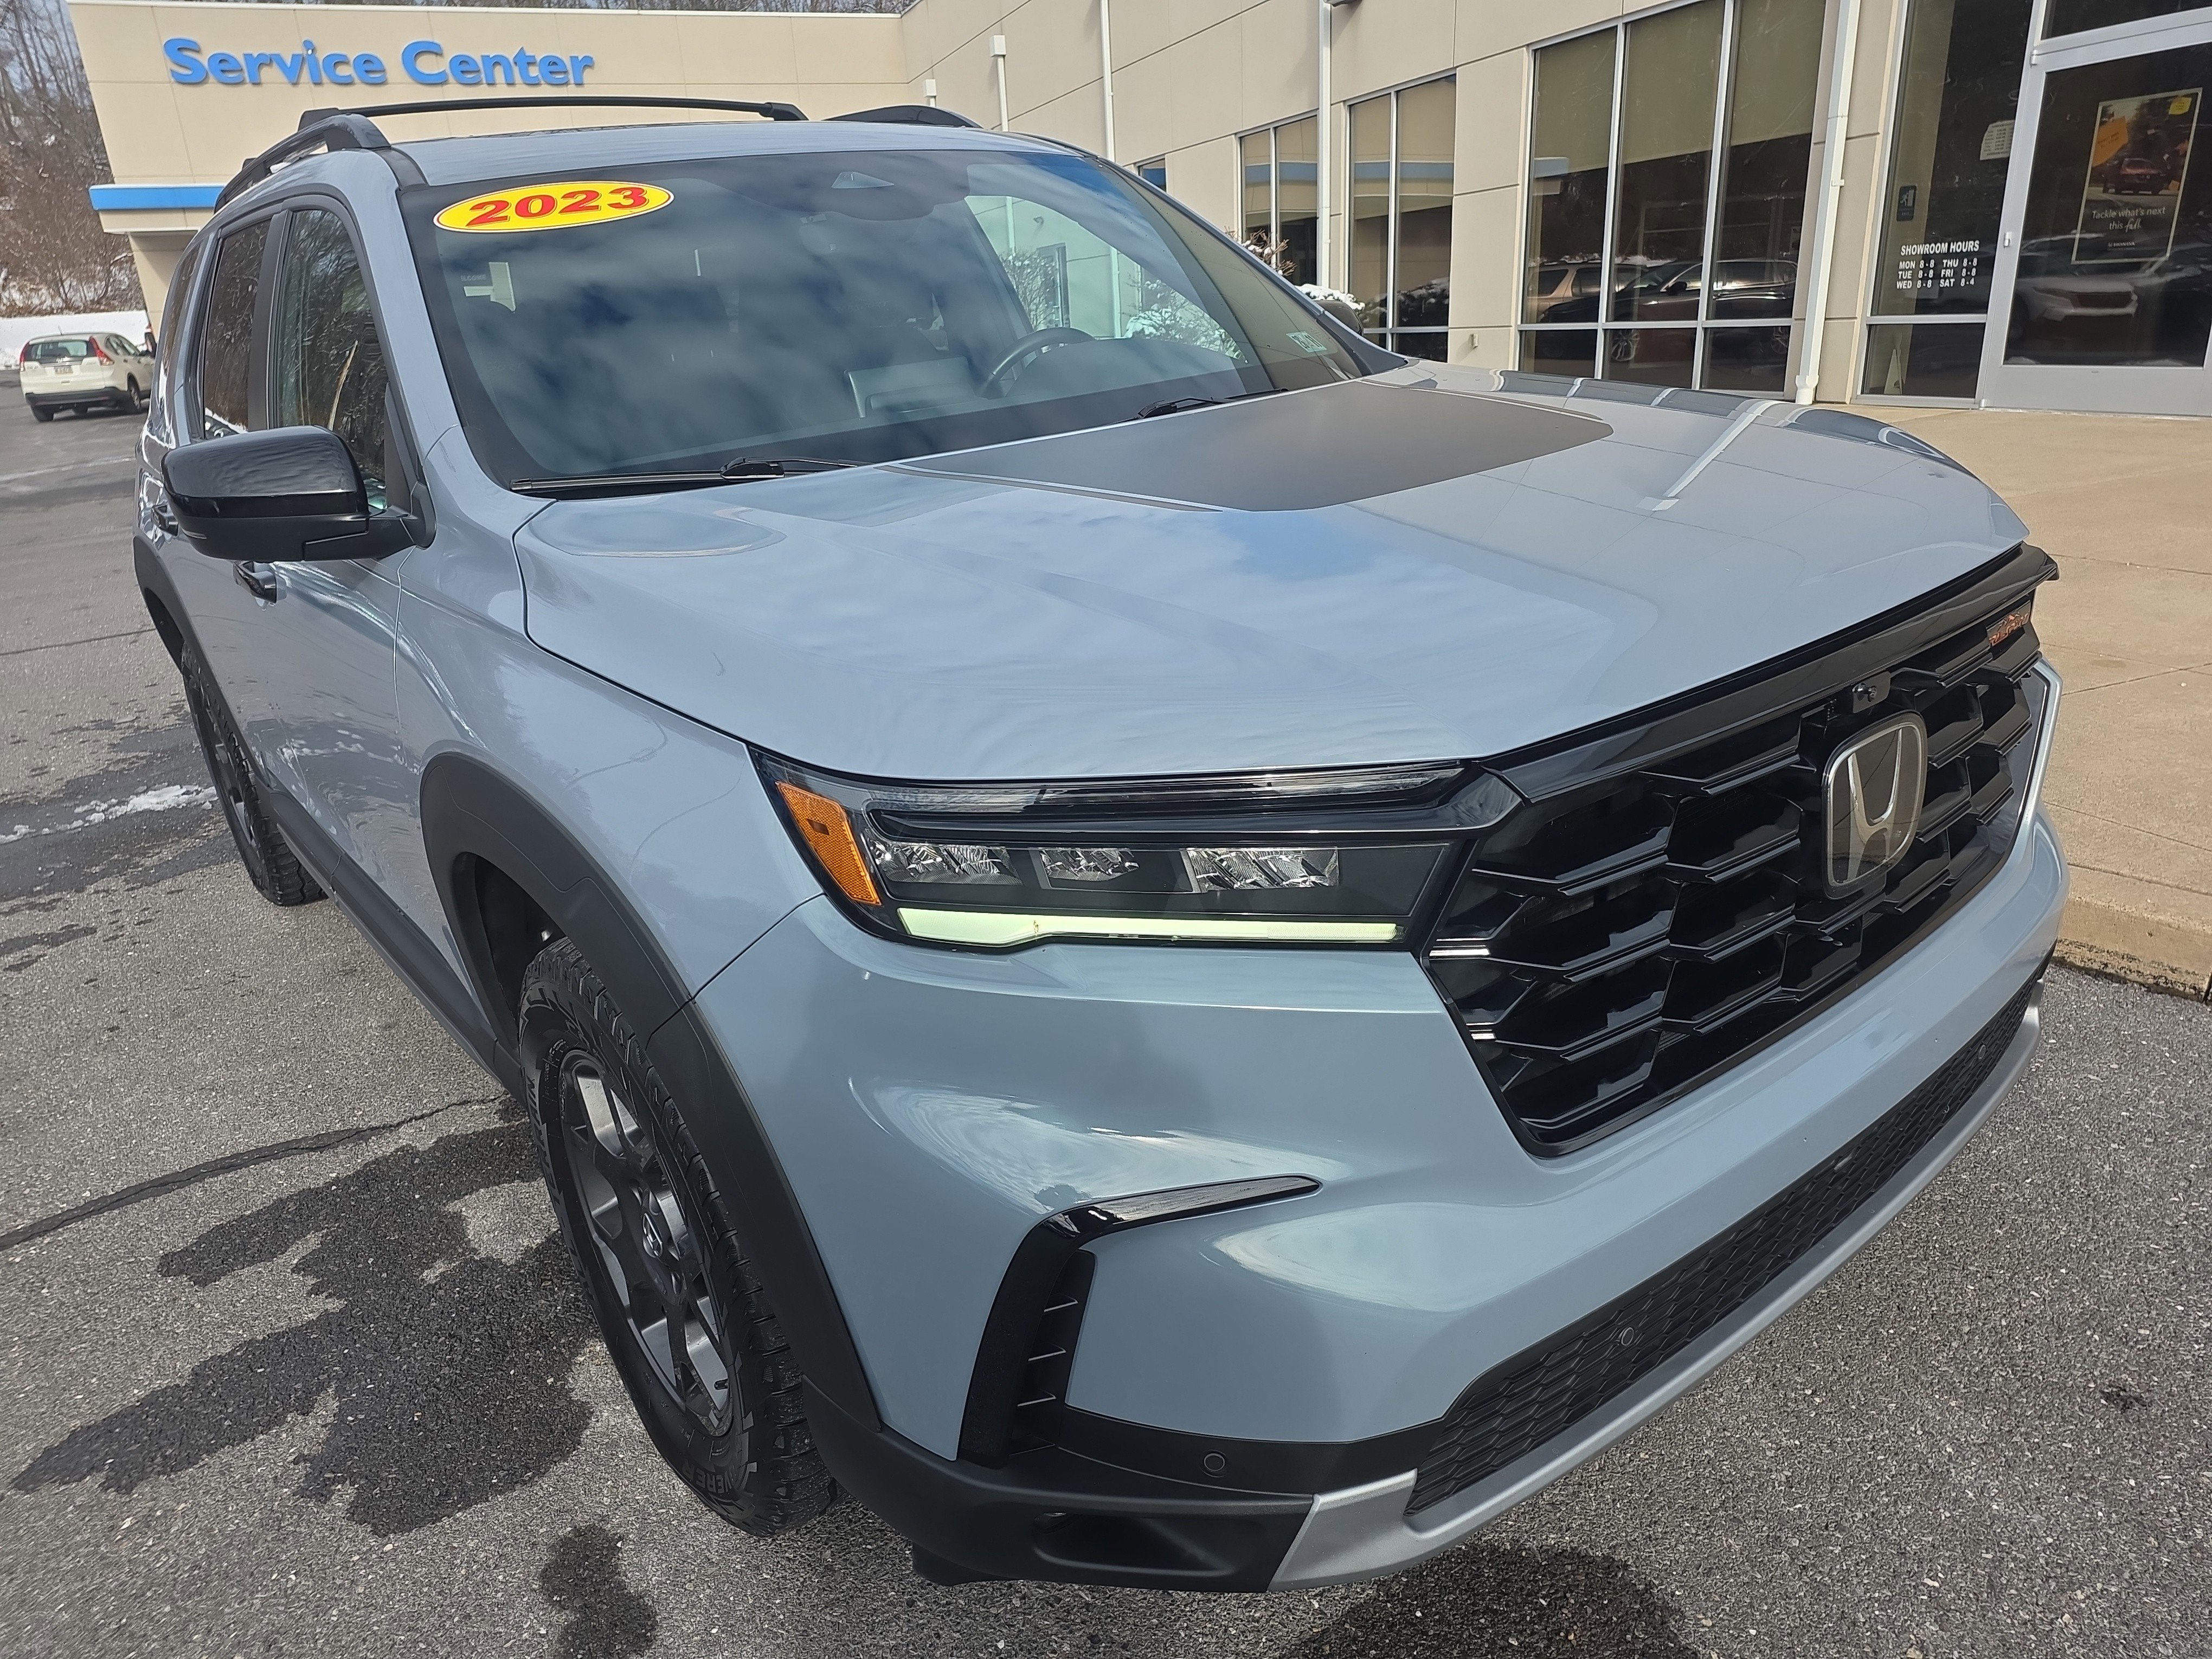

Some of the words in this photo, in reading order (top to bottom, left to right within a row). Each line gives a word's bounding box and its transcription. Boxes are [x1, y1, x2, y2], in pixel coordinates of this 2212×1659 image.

[163, 37, 388, 85] Service
[401, 40, 594, 85] Center
[465, 187, 650, 227] 2023
[2092, 209, 2117, 219] Tackle
[2119, 208, 2144, 217] what's
[2146, 207, 2165, 215] next
[2110, 221, 2123, 230] this
[1900, 242, 1948, 256] SHOWROOM
[1950, 240, 1980, 253] HOURS
[1899, 261, 1915, 269] MON
[1943, 259, 1959, 267] THU
[1898, 271, 1912, 279] TUE
[1941, 269, 1953, 278] FRI
[1896, 280, 1912, 289] WED
[1939, 279, 1955, 287] SAT
